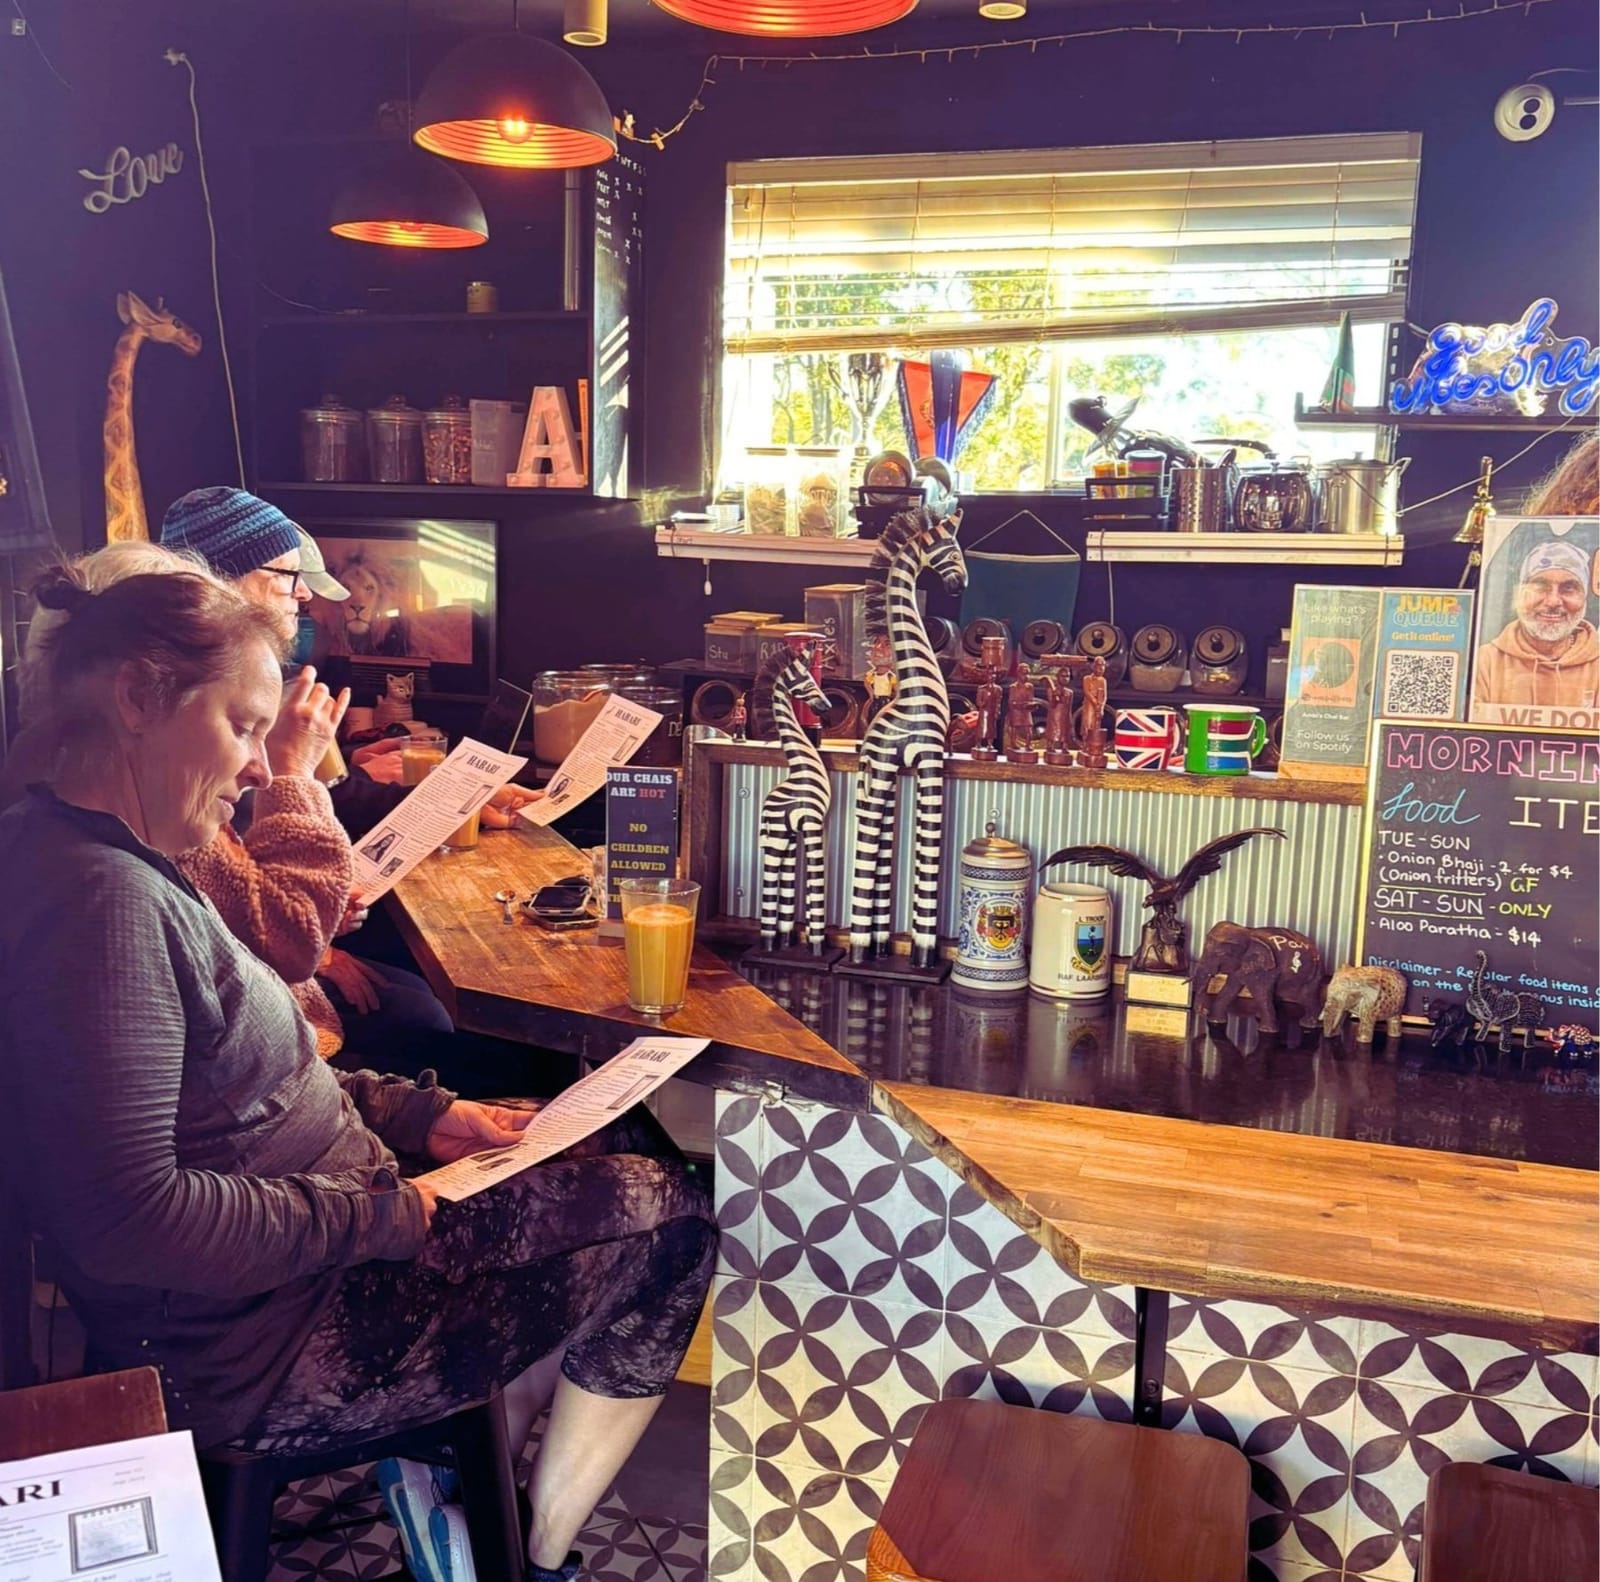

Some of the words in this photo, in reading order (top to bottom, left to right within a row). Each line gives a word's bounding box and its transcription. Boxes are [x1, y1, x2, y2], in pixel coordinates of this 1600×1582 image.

[79, 142, 184, 213] Love
[1424, 298, 1556, 378] good
[1499, 337, 1600, 411] only
[506, 386, 586, 488] A
[1396, 595, 1459, 614] JUMP
[1393, 610, 1459, 628] QUEUE
[1297, 729, 1334, 741] Follow
[1336, 733, 1350, 741] us
[1296, 741, 1310, 749] on
[1312, 740, 1353, 754] Spotify
[634, 773, 673, 784] CHAIS
[610, 786, 637, 798] ARE
[639, 788, 667, 799] HOT
[629, 823, 648, 833] NO
[610, 842, 670, 855] CHILDREN
[610, 860, 667, 872] ALLOWED
[1388, 850, 1436, 866] Onion
[1441, 854, 1484, 875] Bhaji
[1518, 863, 1543, 874] for
[1549, 865, 1574, 880] $4
[1379, 866, 1432, 883] (Onion
[1434, 867, 1502, 892] fritters)
[1510, 877, 1541, 893] GF
[1498, 901, 1553, 920] ONLY
[1379, 917, 1414, 932] Aloo
[1419, 919, 1492, 940] Paratha
[1507, 925, 1542, 949] $14
[1368, 955, 1442, 977] Disclaimer
[1456, 965, 1513, 983] Reular
[1518, 973, 1549, 989] food
[1551, 978, 1589, 995] items
[1412, 979, 1431, 987] on
[1435, 980, 1464, 992] the
